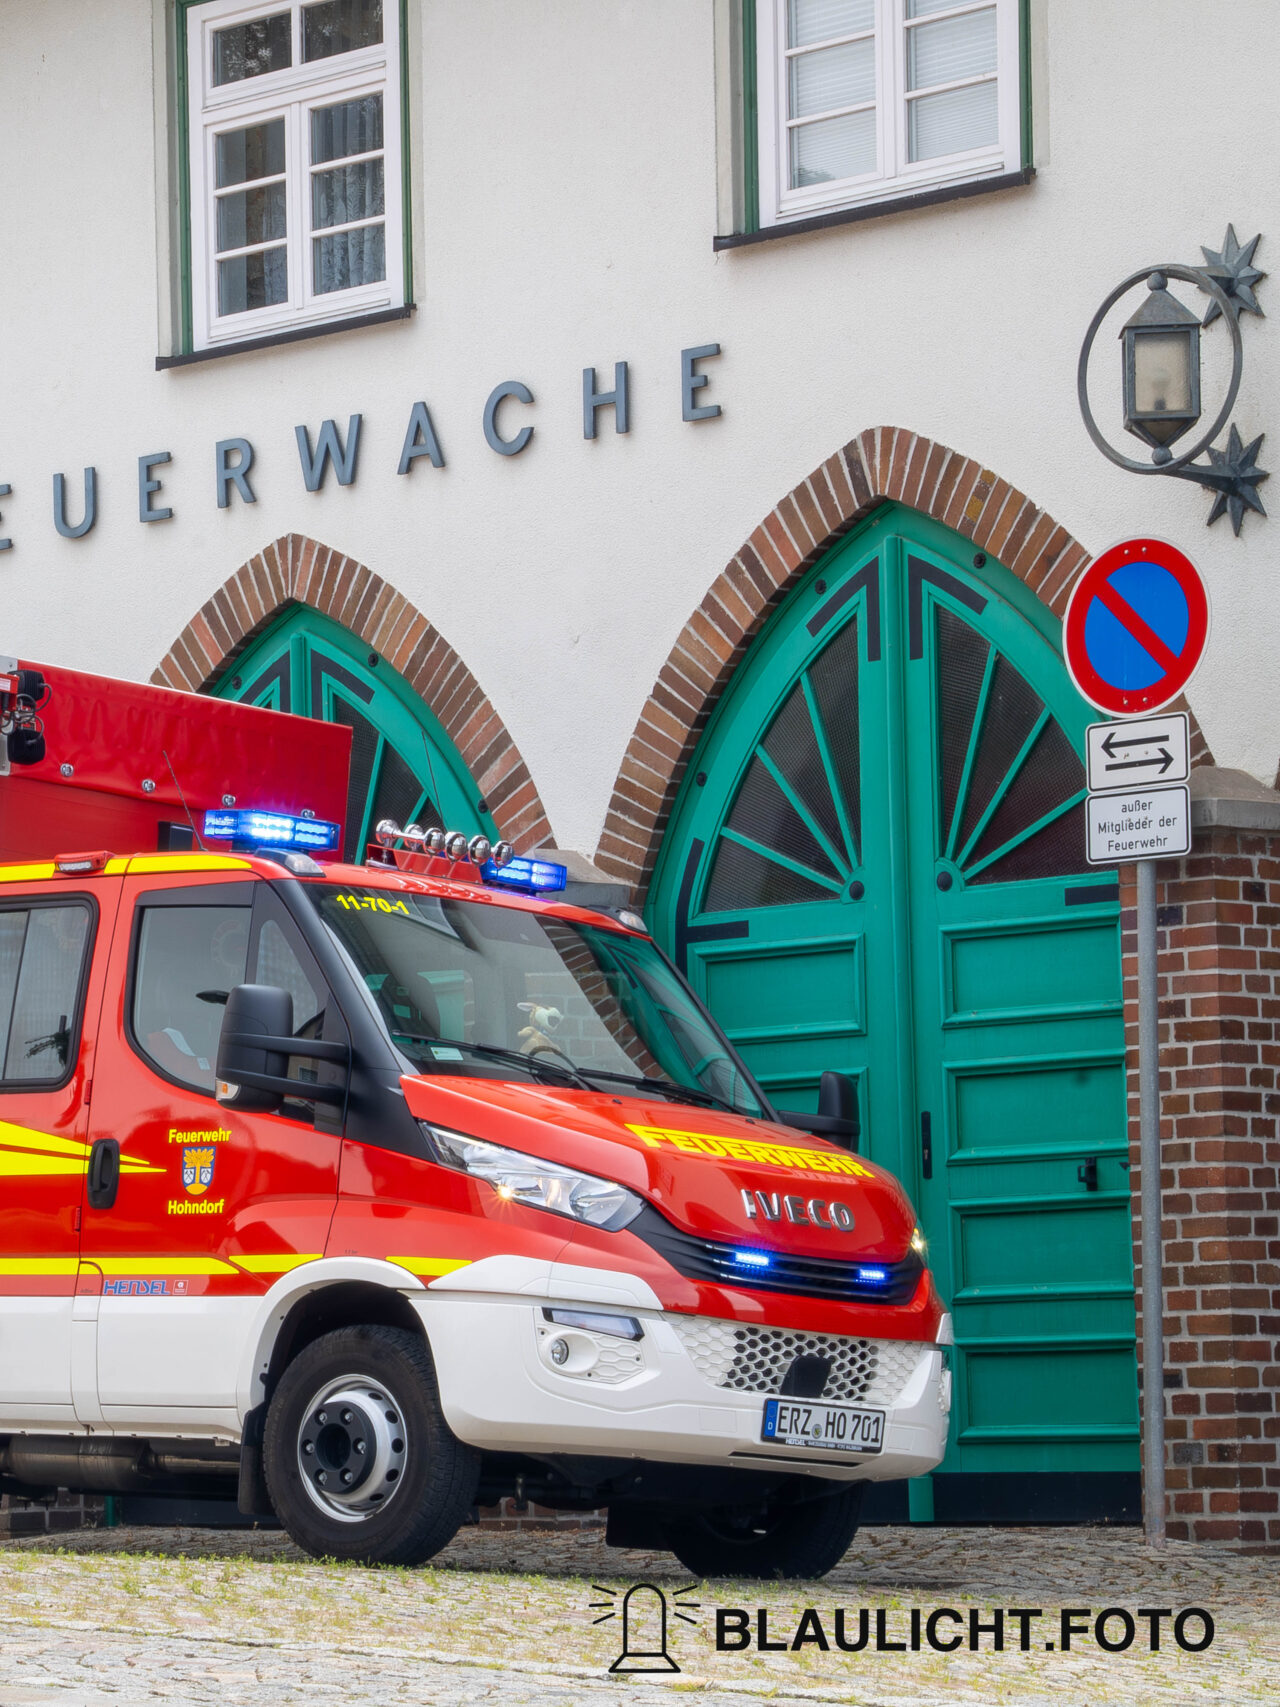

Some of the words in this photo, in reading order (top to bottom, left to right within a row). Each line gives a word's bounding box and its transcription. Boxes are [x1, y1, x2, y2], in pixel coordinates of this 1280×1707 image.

[1121, 799, 1153, 813] außer
[1097, 818, 1153, 836] Mitglieder
[1158, 816, 1178, 828] der
[1107, 835, 1169, 852] Feuerwehr
[335, 894, 410, 916] 11-70-1
[167, 1127, 233, 1144] Feuerwehr
[624, 1123, 876, 1179] FEUERWEHR
[167, 1198, 225, 1215] Hohndorf
[740, 1188, 856, 1233] IVECO
[103, 1279, 171, 1296] HENSEL
[777, 1405, 812, 1436] ERZ
[824, 1411, 847, 1440] HO
[851, 1414, 881, 1443] 701
